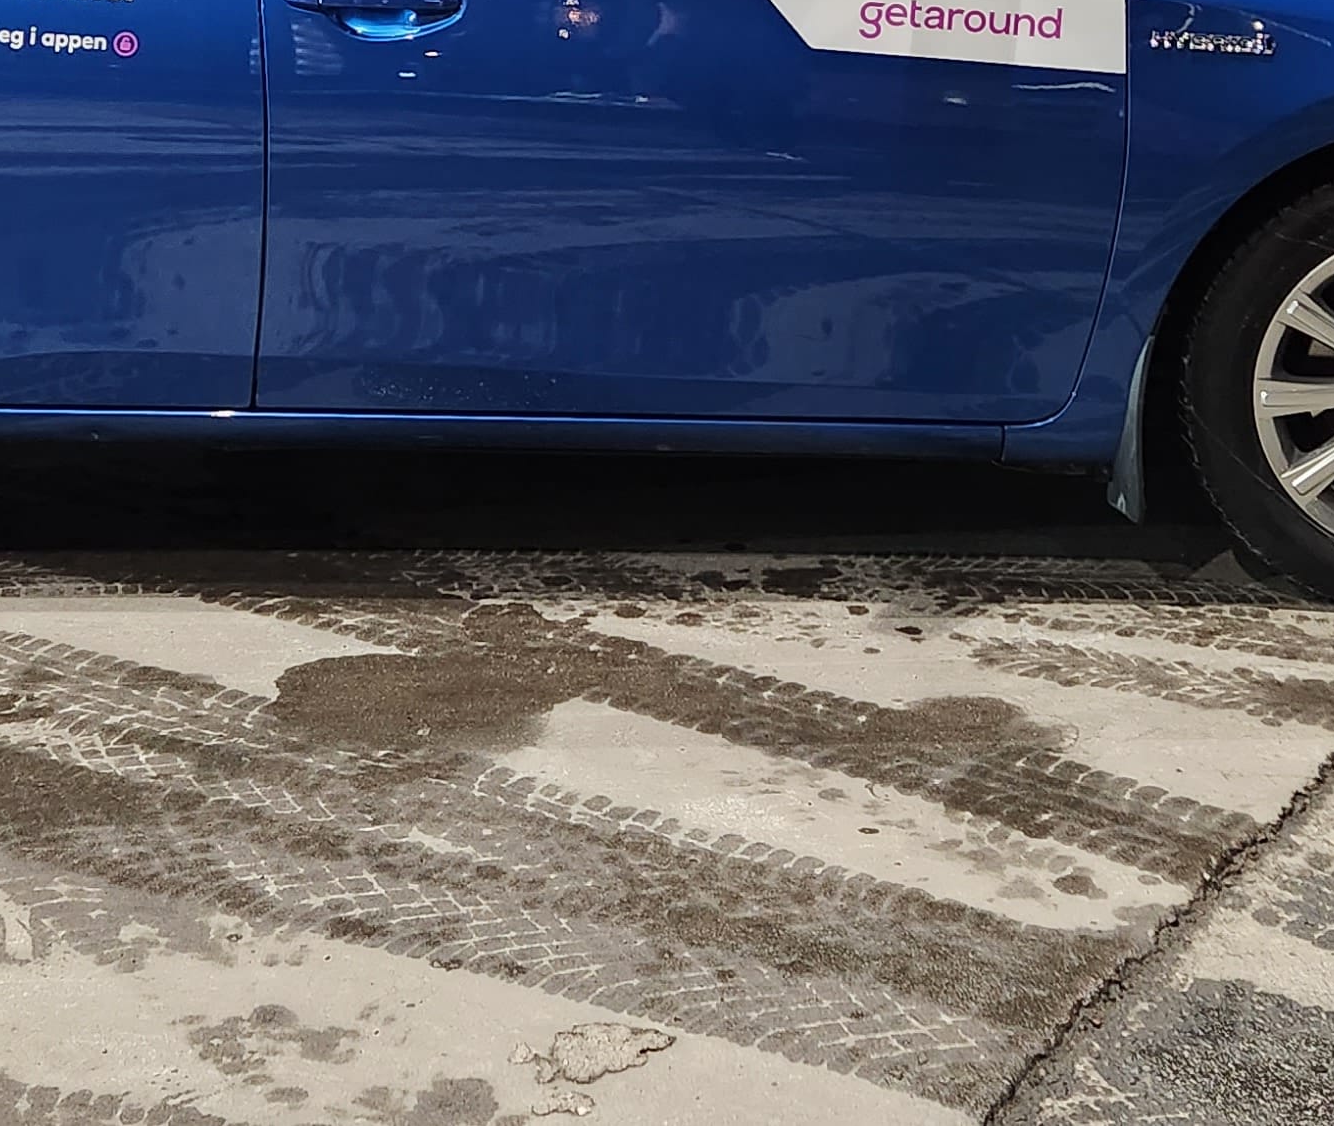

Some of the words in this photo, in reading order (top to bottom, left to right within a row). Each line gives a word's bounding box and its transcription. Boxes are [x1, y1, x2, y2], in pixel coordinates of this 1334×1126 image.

[858, 0, 1063, 40] getaround
[28, 26, 37, 46] i
[40, 33, 108, 54] appen
